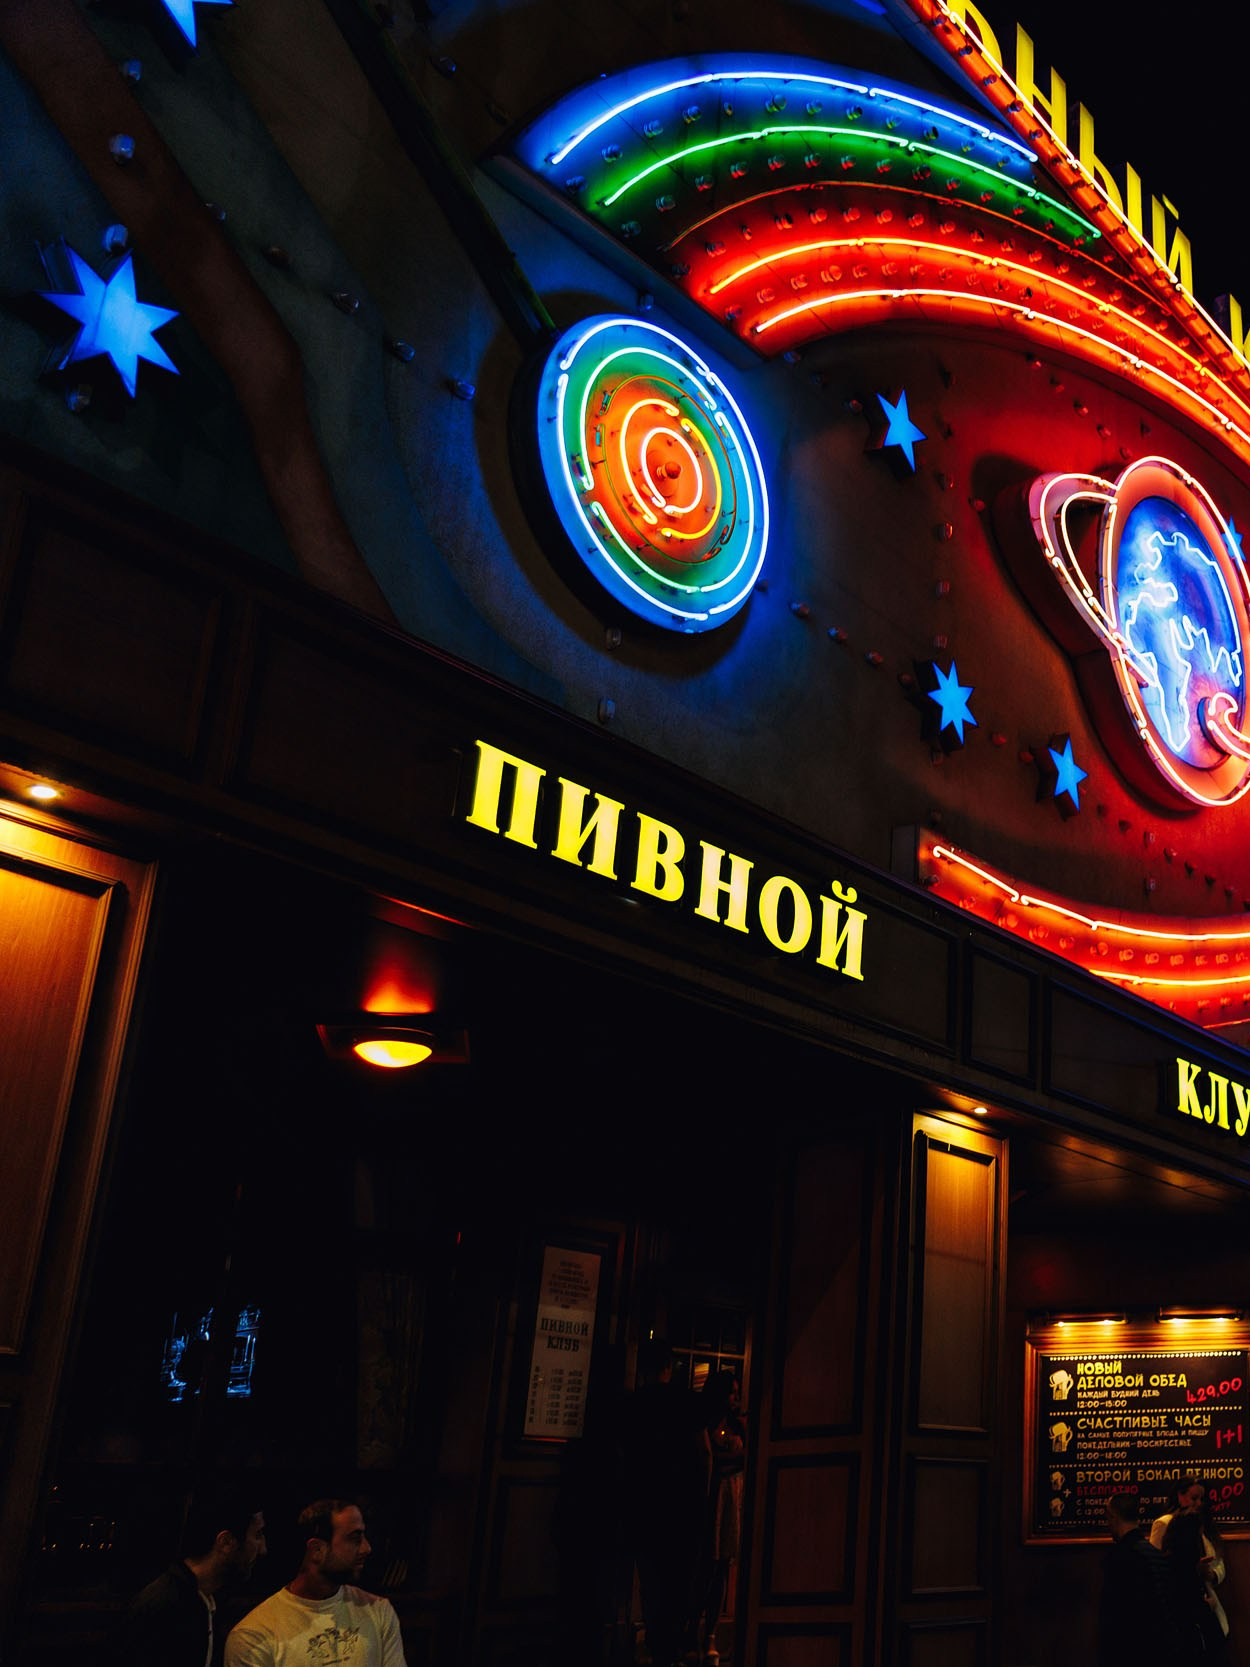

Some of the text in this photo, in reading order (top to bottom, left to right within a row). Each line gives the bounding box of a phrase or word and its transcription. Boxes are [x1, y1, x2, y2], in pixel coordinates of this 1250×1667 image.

[465, 739, 868, 981] ПИВНОЙ
[540, 1318, 588, 1336] ПИВНОЙ
[547, 1335, 579, 1352] КЛУБ
[1077, 1361, 1122, 1375] НОВЫЙ
[1077, 1373, 1187, 1390] ДЕЛОВОЙ ОБЕД
[1077, 1389, 1160, 1399] КАЖДЫЙ БУДНИЙ ДЕНЬ
[1077, 1414, 1211, 1430] СЧАСТЛИВЫЕ ЧАСЫ
[1088, 1431, 1110, 1439] САМЫЕ
[1113, 1430, 1154, 1438] ПОПУЛЯРНЫЕ
[1215, 1424, 1243, 1449] 1+1
[1076, 1469, 1131, 1483] ВТОРОЙ
[1137, 1468, 1180, 1482] БОКАЛ
[1076, 1485, 1140, 1497] БЕСПЛАТНО
